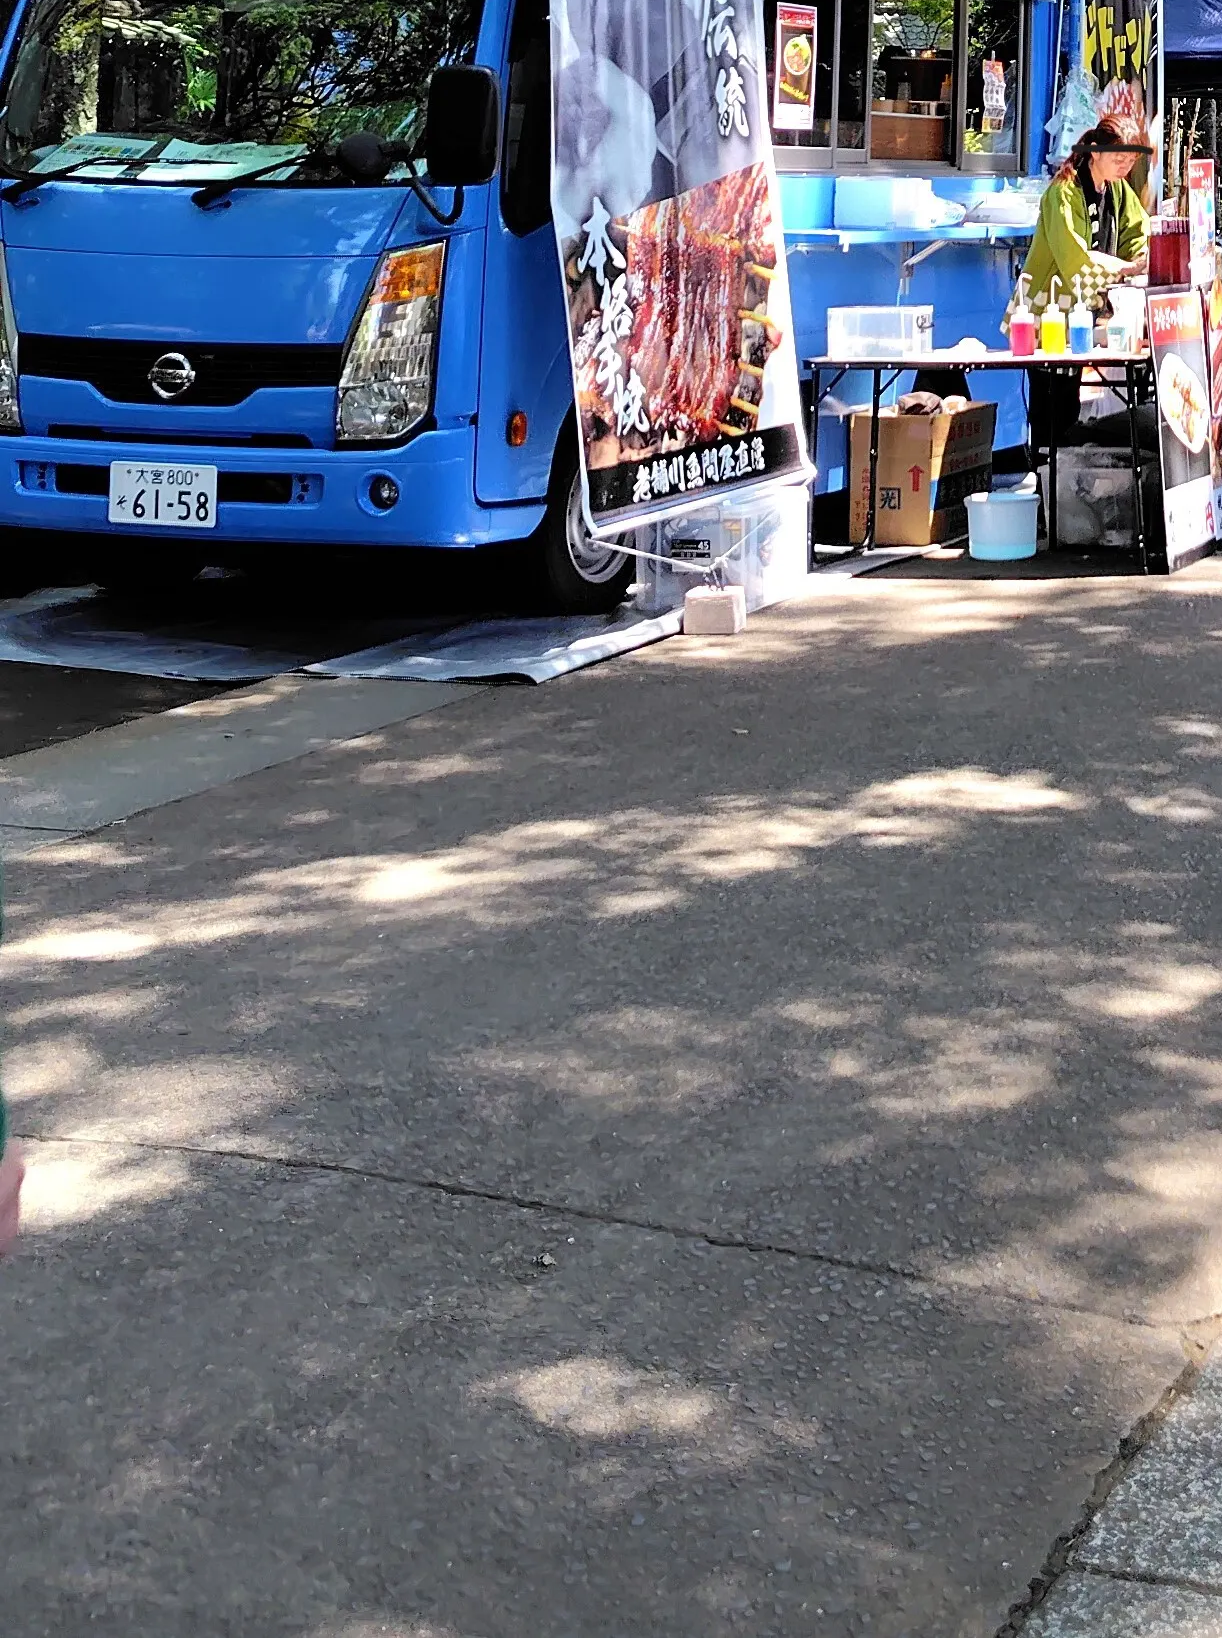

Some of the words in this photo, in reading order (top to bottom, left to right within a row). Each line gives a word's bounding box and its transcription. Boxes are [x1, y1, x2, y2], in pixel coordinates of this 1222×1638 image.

[1153, 303, 1198, 332] うなぎの串
[132, 488, 209, 521] 61-58
